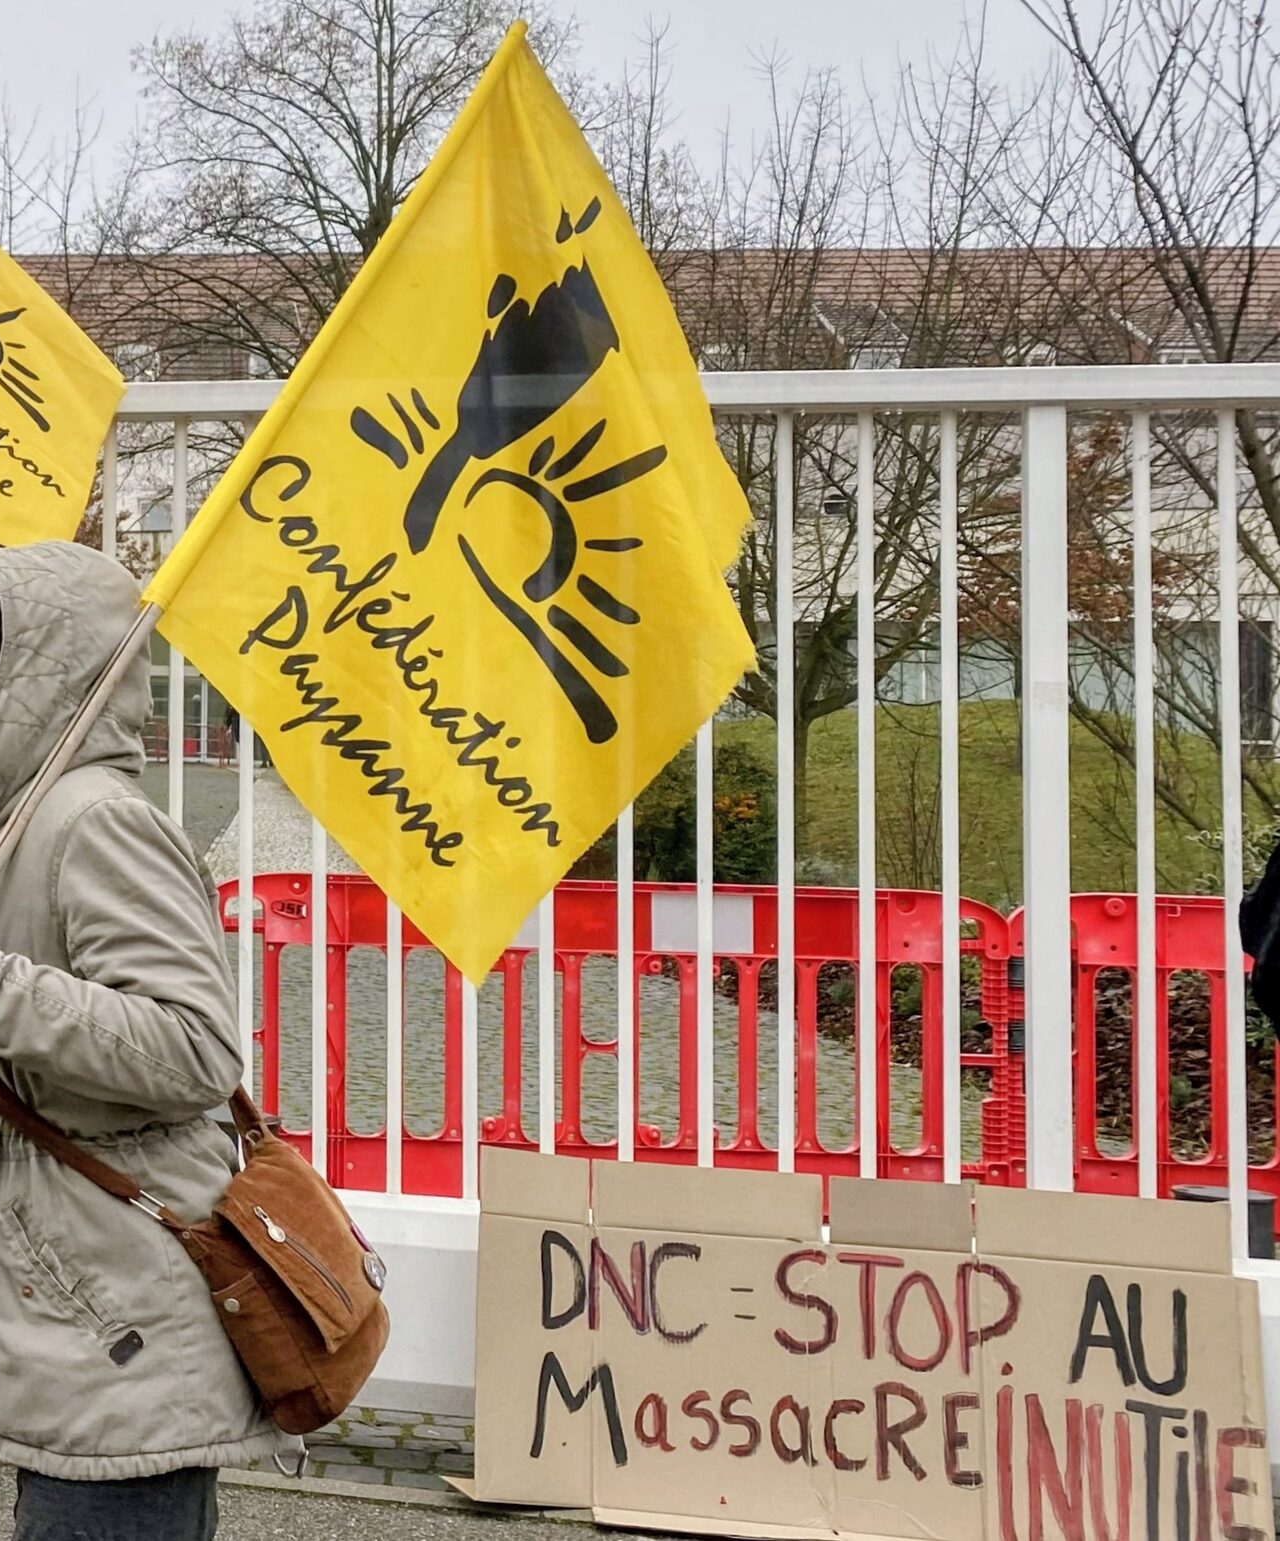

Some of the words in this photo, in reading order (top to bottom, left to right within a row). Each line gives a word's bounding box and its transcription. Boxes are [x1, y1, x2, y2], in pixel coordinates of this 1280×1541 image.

[238, 585, 464, 868] Paysanne
[239, 455, 562, 847] Confédération
[540, 1229, 710, 1343] DNC
[1068, 1274, 1187, 1396] AU
